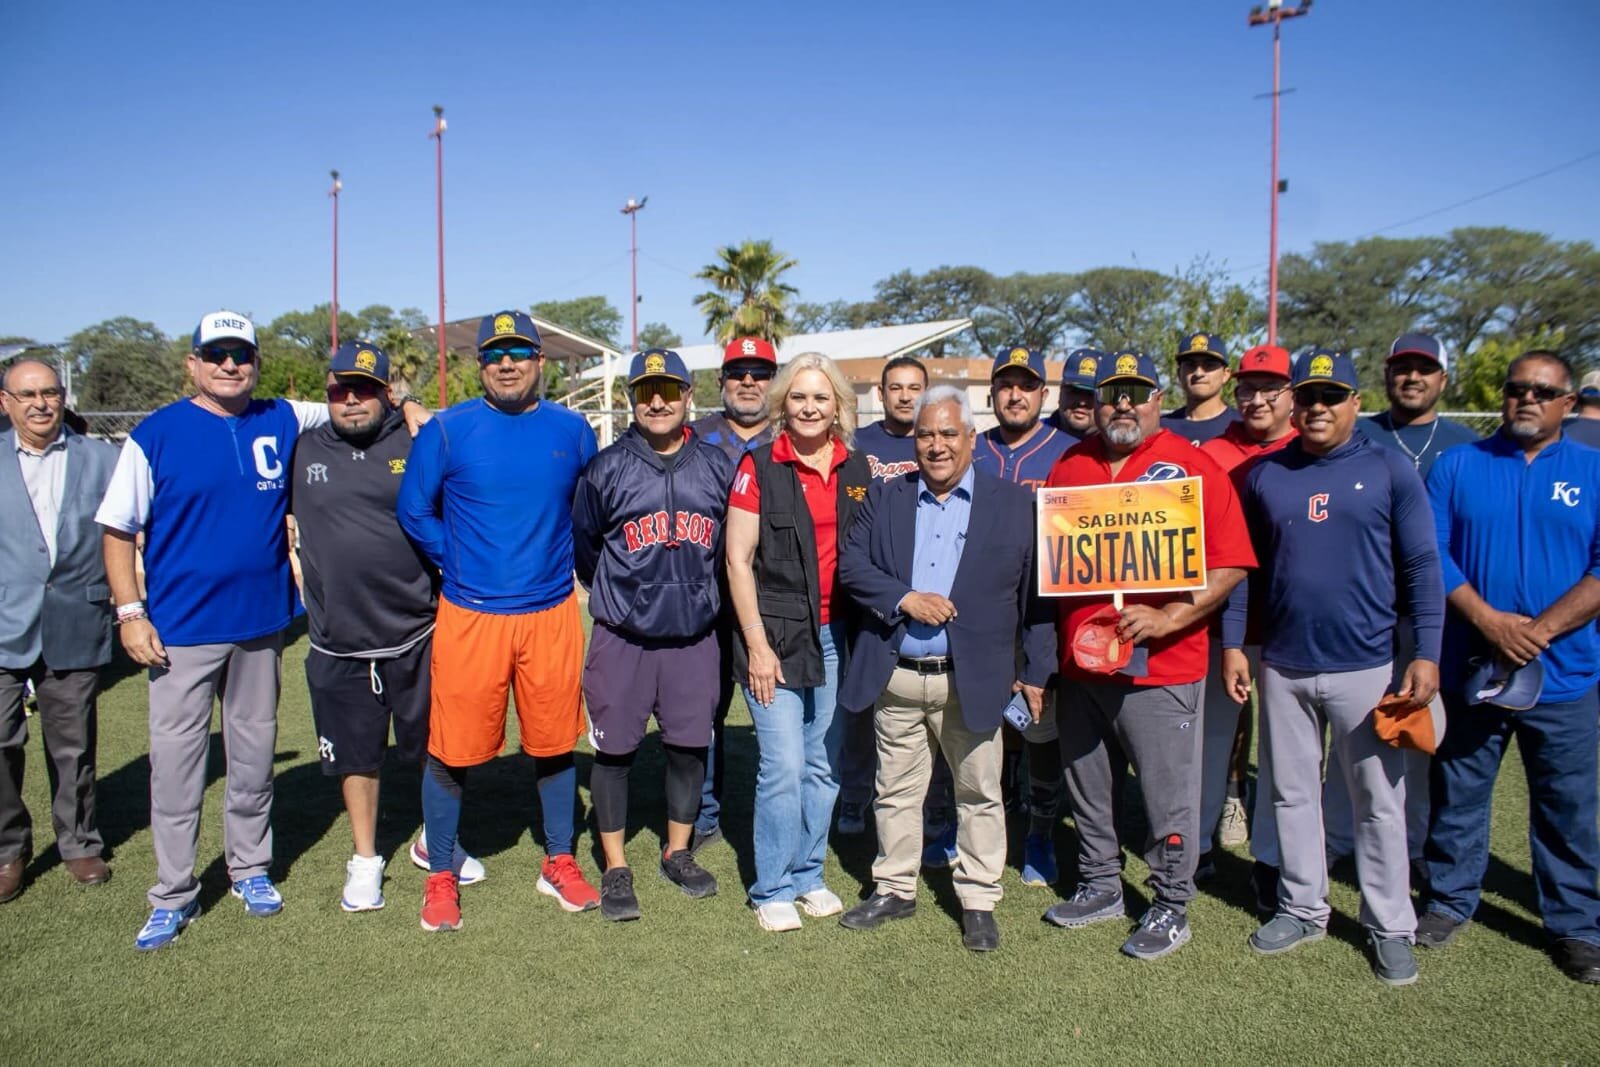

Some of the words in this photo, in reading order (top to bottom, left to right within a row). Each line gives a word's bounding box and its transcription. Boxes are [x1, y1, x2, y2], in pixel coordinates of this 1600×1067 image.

[214, 319, 246, 330] ENEF
[253, 436, 283, 480] C
[1182, 485, 1190, 495] 5
[1551, 481, 1580, 507] KC
[1078, 510, 1167, 529] SABINAS
[1308, 493, 1330, 523] C
[623, 510, 670, 553] RED
[676, 510, 714, 549] SOX
[1046, 526, 1199, 586] VISITANTE
